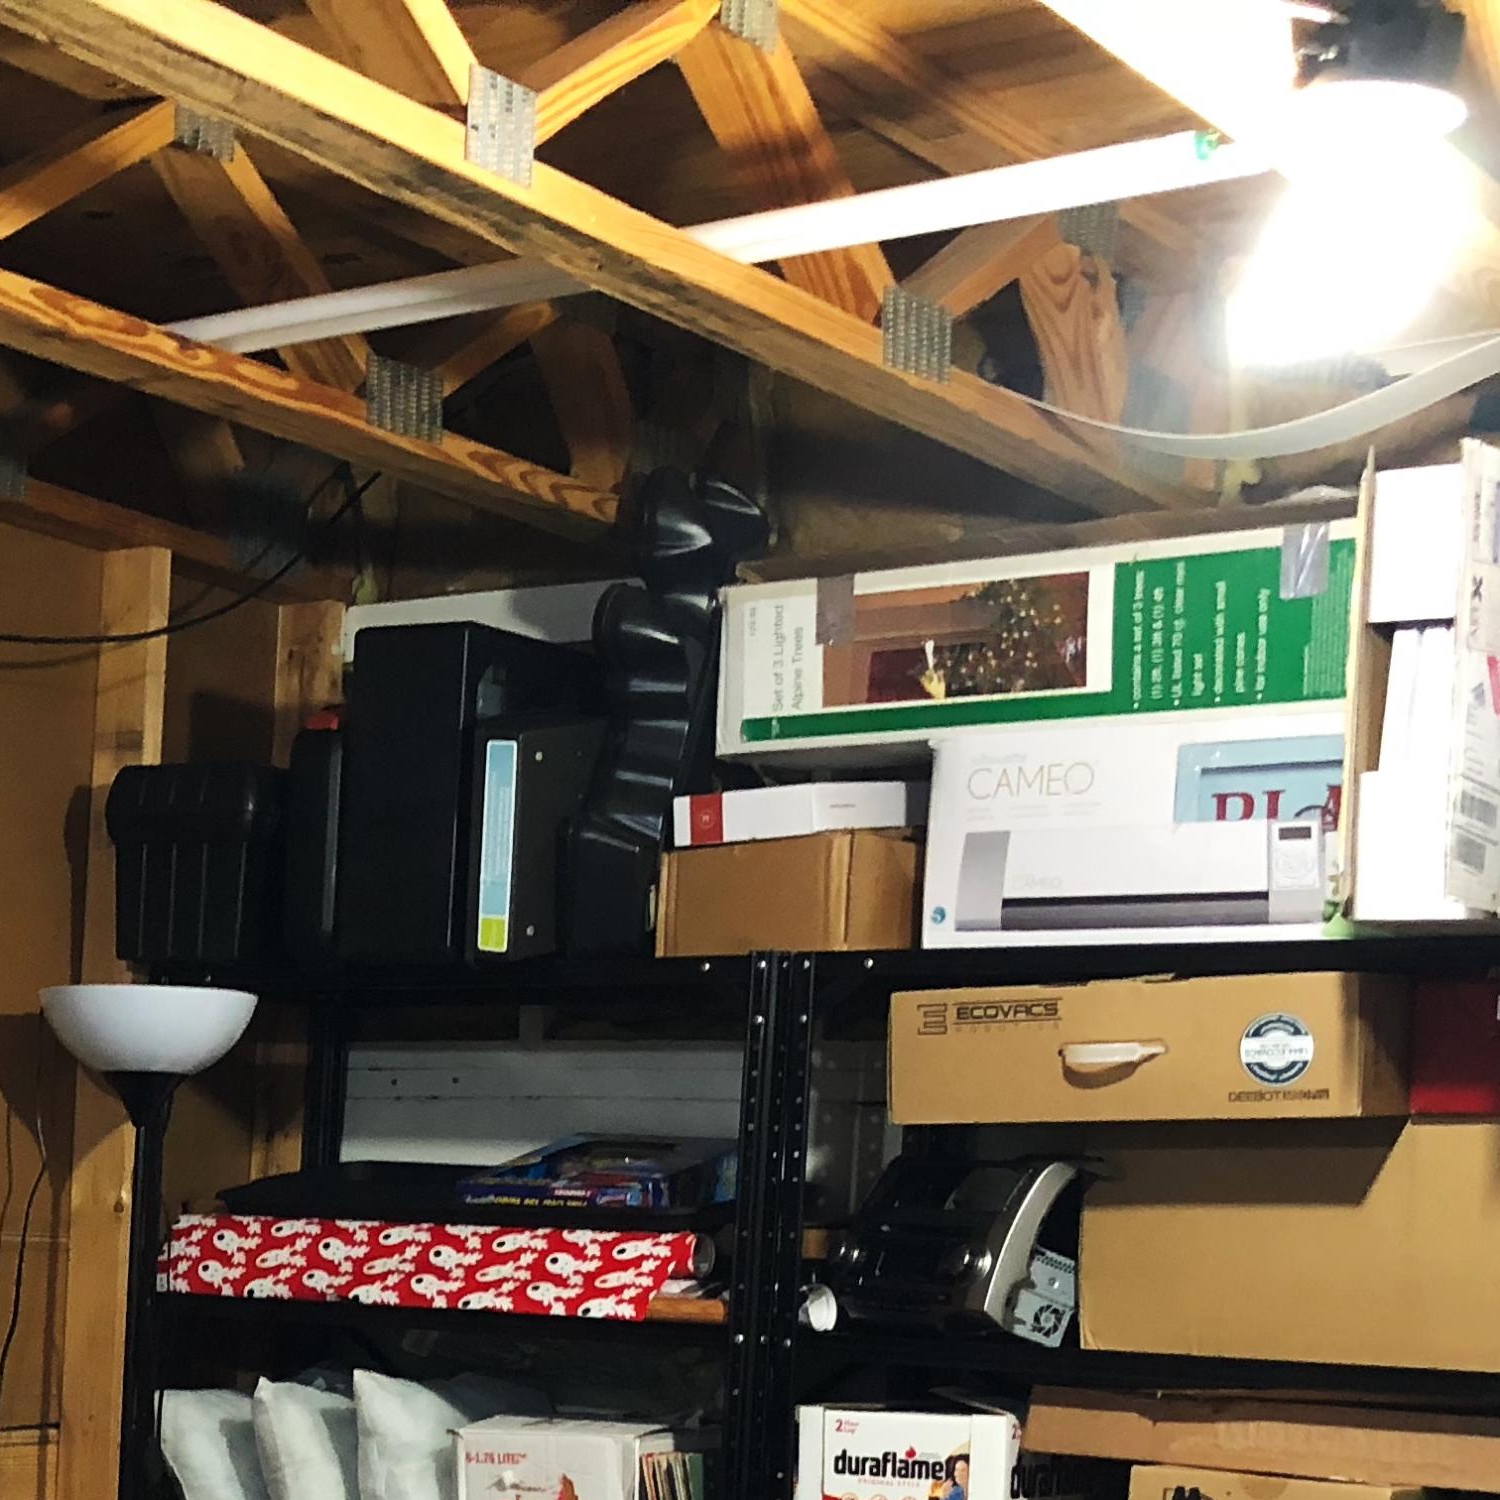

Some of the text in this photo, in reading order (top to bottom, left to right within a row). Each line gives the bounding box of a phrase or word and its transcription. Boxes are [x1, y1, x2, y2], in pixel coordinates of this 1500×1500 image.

[1257, 588, 1270, 613] only
[771, 605, 786, 712] Set of 3 Lighted
[791, 626, 804, 711] Alpine Trees
[966, 761, 1096, 801] CAMEO
[956, 1002, 1059, 1020] ECOVACS
[835, 1418, 843, 1433] 2
[498, 1452, 527, 1466] LITE
[833, 1448, 946, 1481] duraflame
